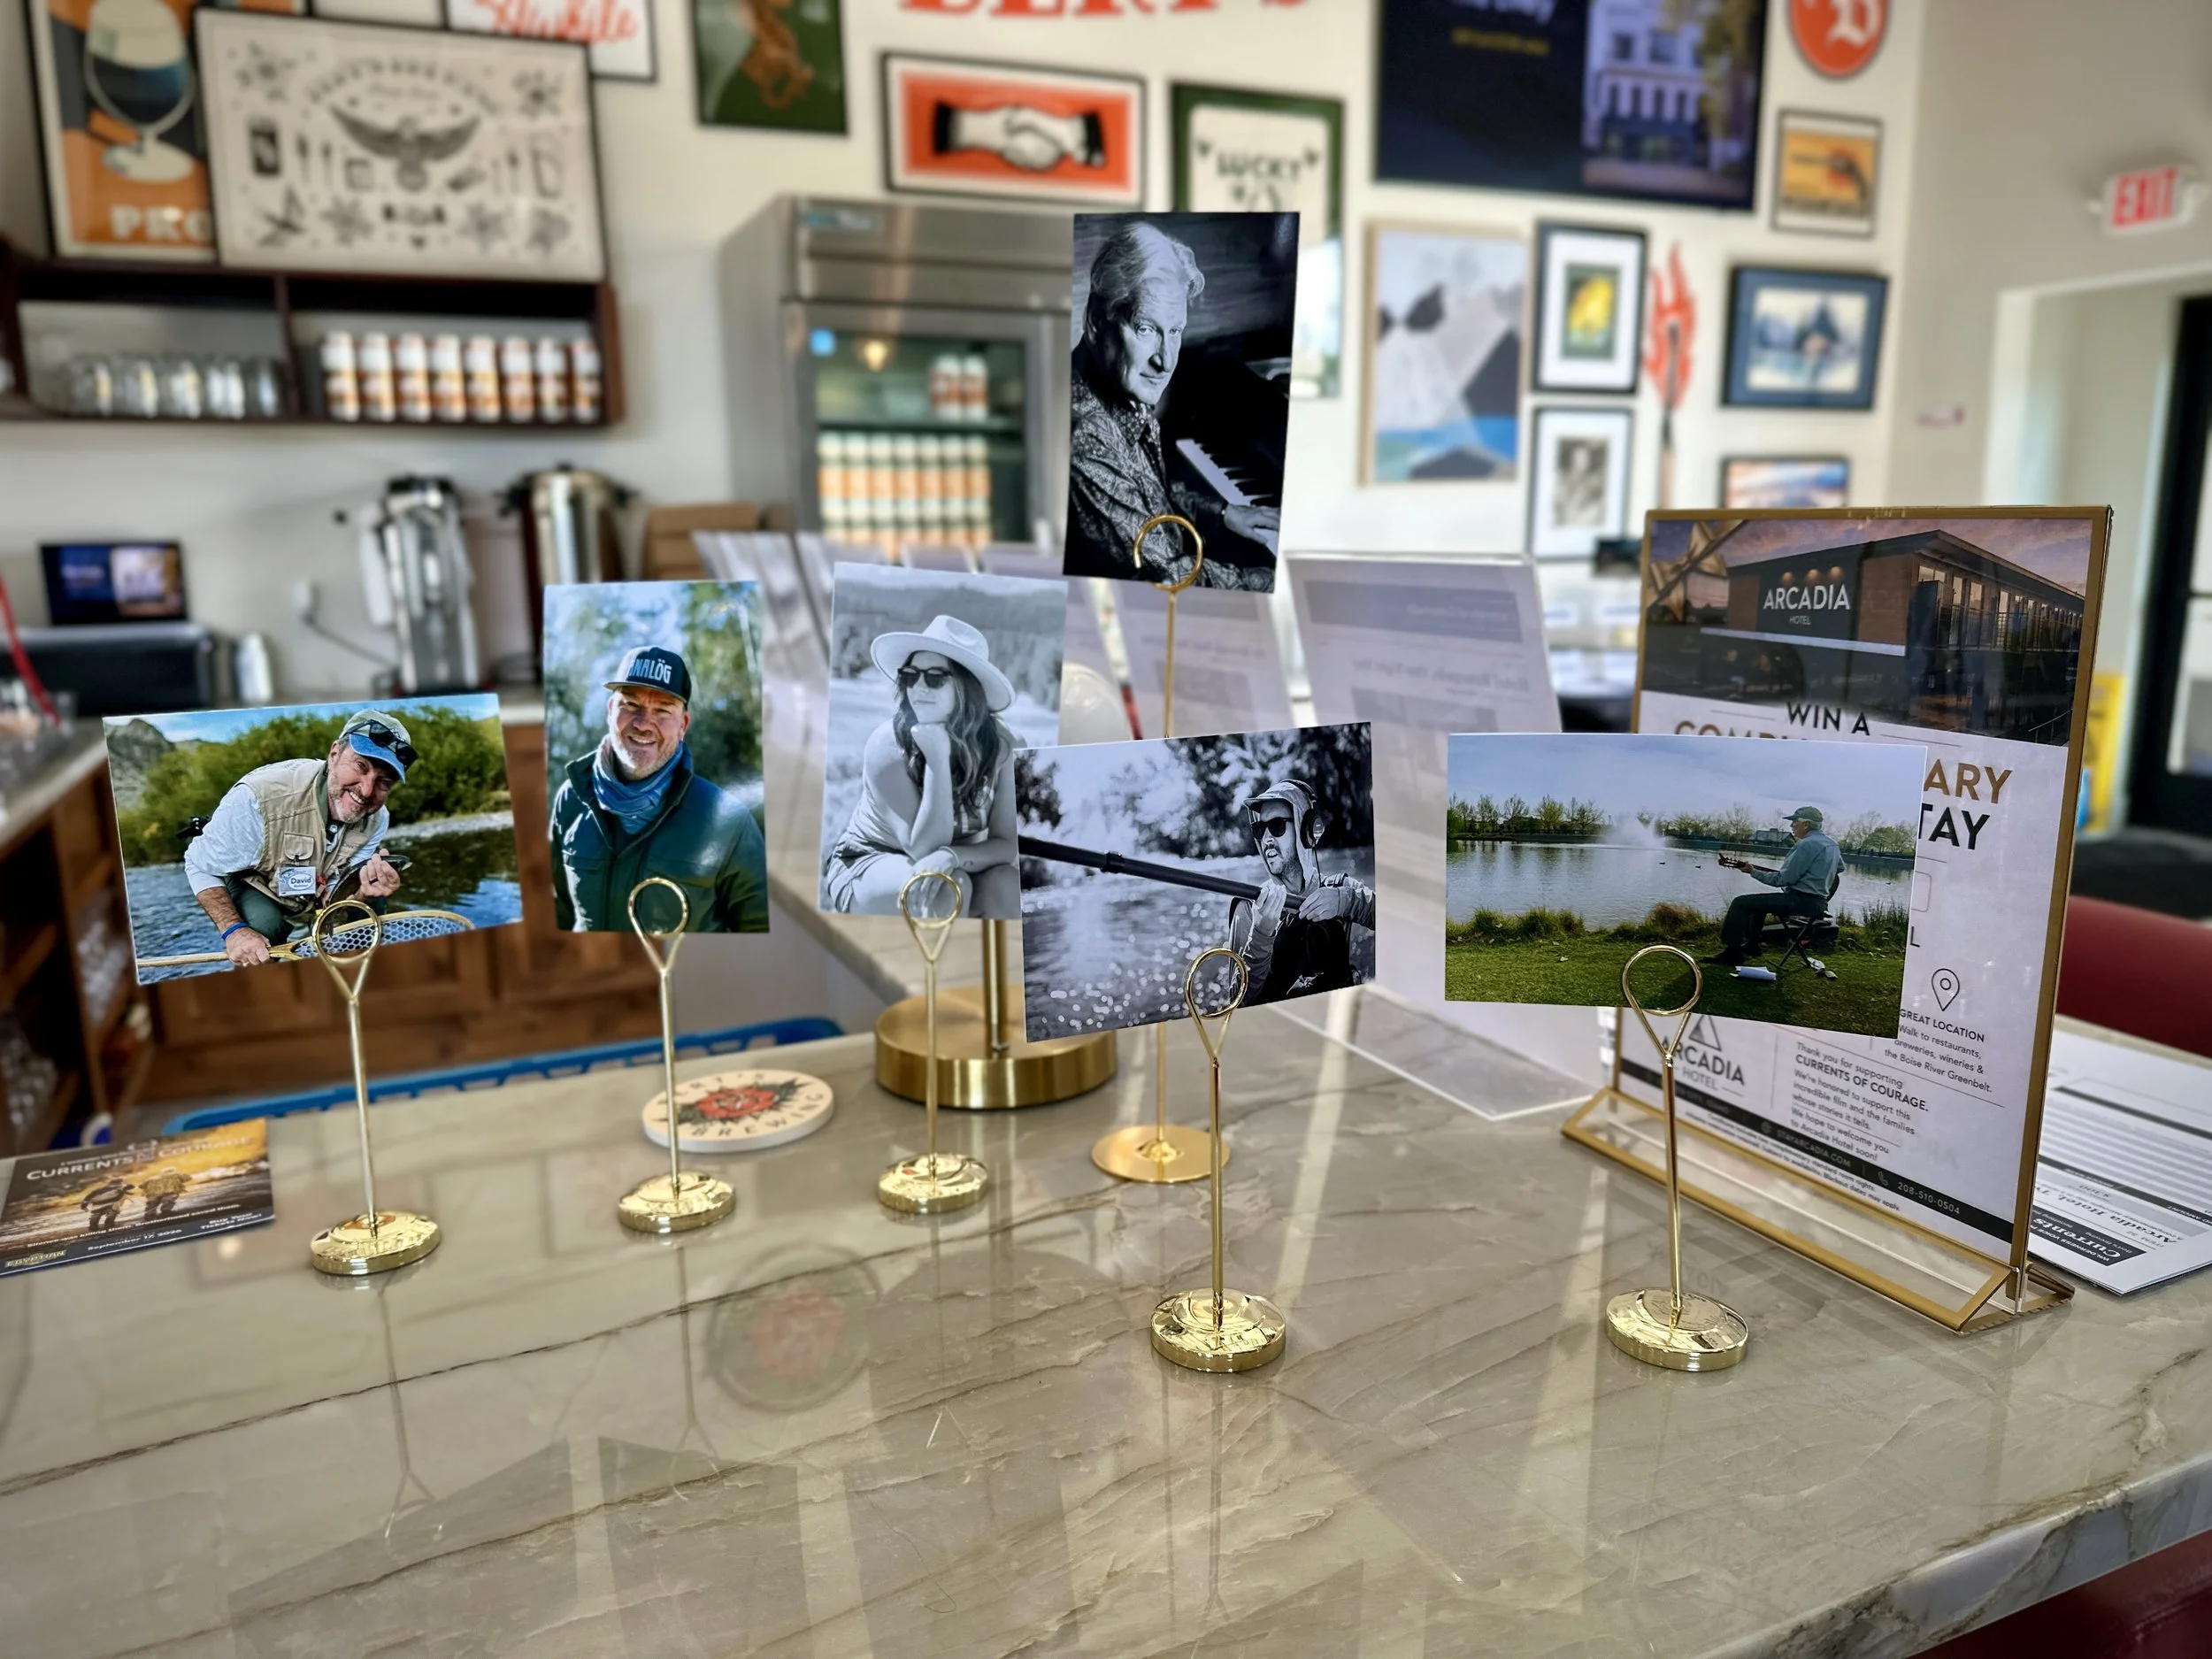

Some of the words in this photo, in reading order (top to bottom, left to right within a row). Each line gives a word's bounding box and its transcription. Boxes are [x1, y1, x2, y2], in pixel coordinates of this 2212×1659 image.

[2113, 165, 2177, 227] EXIT
[1763, 584, 1851, 610] ARCADIA
[1789, 615, 1811, 625] HOTEL
[1787, 702, 1841, 732] WIN
[1851, 710, 1870, 736] A
[1924, 759, 2013, 804] ARY
[1918, 803, 1991, 850] TAY
[1899, 1024, 1918, 1037] Walk
[1932, 1036, 1982, 1060] restaurants,
[1900, 1009, 1931, 1025] GREAT
[1932, 1018, 1985, 1042] LOCATION
[1682, 1067, 1719, 1091] HOTEL
[1797, 1041, 1820, 1057] Thank
[1823, 1054, 1838, 1064] you
[1840, 1057, 1853, 1068] for
[1855, 1065, 1903, 1089] supporting
[1885, 1048, 1897, 1060] the
[1900, 1053, 1922, 1068] Boise
[1924, 1062, 1946, 1076] River
[1947, 1071, 1993, 1093] Greenbelt.
[1939, 1054, 1974, 1071] wineries
[1977, 1064, 1984, 1074] &
[1794, 1068, 1816, 1083] We're
[1817, 1078, 1849, 1096] honored
[1852, 1092, 1860, 1101] to
[1863, 1097, 1893, 1114] support
[1896, 1109, 1910, 1120] this
[1795, 1054, 1850, 1081] CURRENTS
[1853, 1076, 1868, 1087] OF
[1870, 1082, 1929, 1111] COURAGE.
[1793, 1081, 1831, 1101] incredible
[1833, 1095, 1847, 1107] film
[1849, 1103, 1864, 1115] and
[1867, 1110, 1880, 1120] the
[1883, 1115, 1915, 1134] families
[1793, 1094, 1816, 1107] whose
[1818, 1103, 1843, 1118] stories
[1845, 1112, 1851, 1122] it
[1801, 1123, 1830, 1141] Arcadia
[1832, 1136, 1854, 1150] Hotel
[1805, 1113, 1824, 1126] hope
[1827, 1122, 1835, 1131] to
[1837, 1127, 1872, 1146] welcome
[1875, 1142, 1889, 1154] you
[27, 1156, 133, 1180] CURRENTS
[1898, 1181, 1961, 1215] 208-510-0504
[2033, 1218, 2121, 1257] Currents
[2110, 1216, 2177, 1243] Arcadia
[2061, 1239, 2109, 1262] WILDERNESS
